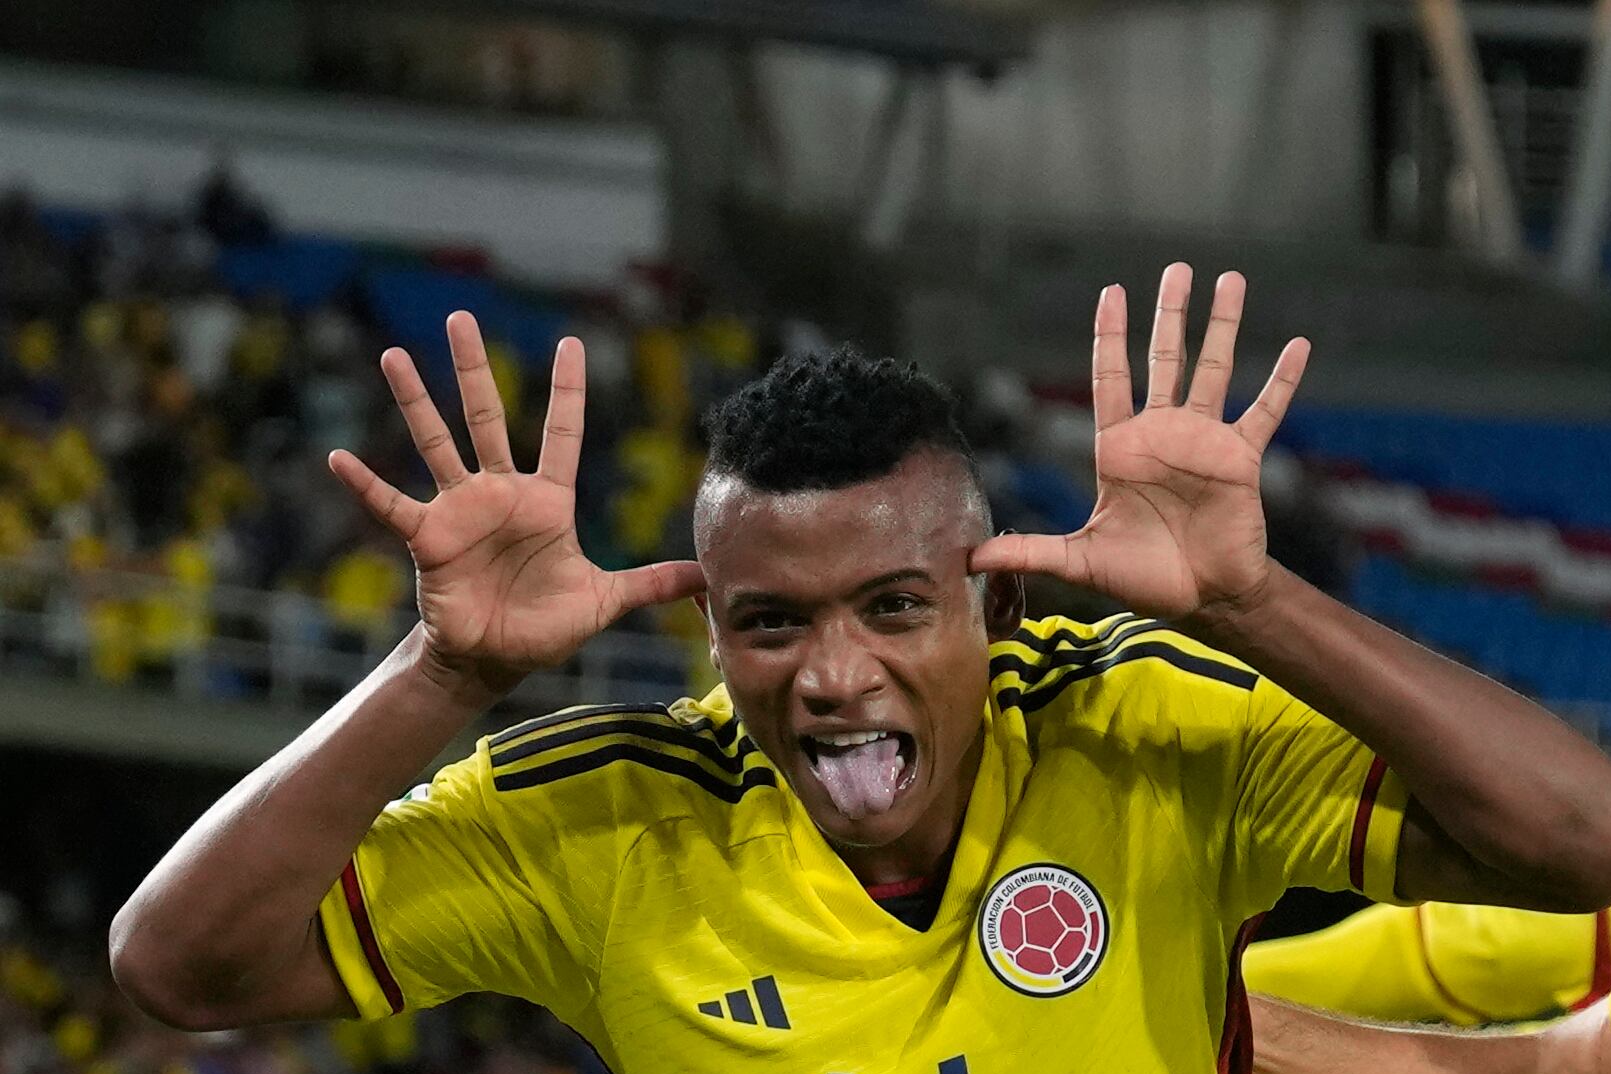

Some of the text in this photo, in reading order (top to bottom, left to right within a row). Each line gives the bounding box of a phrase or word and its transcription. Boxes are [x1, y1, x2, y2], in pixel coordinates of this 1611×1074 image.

[986, 872, 1094, 950] FEDERACION COLOMBIANA DE FUTBOL
